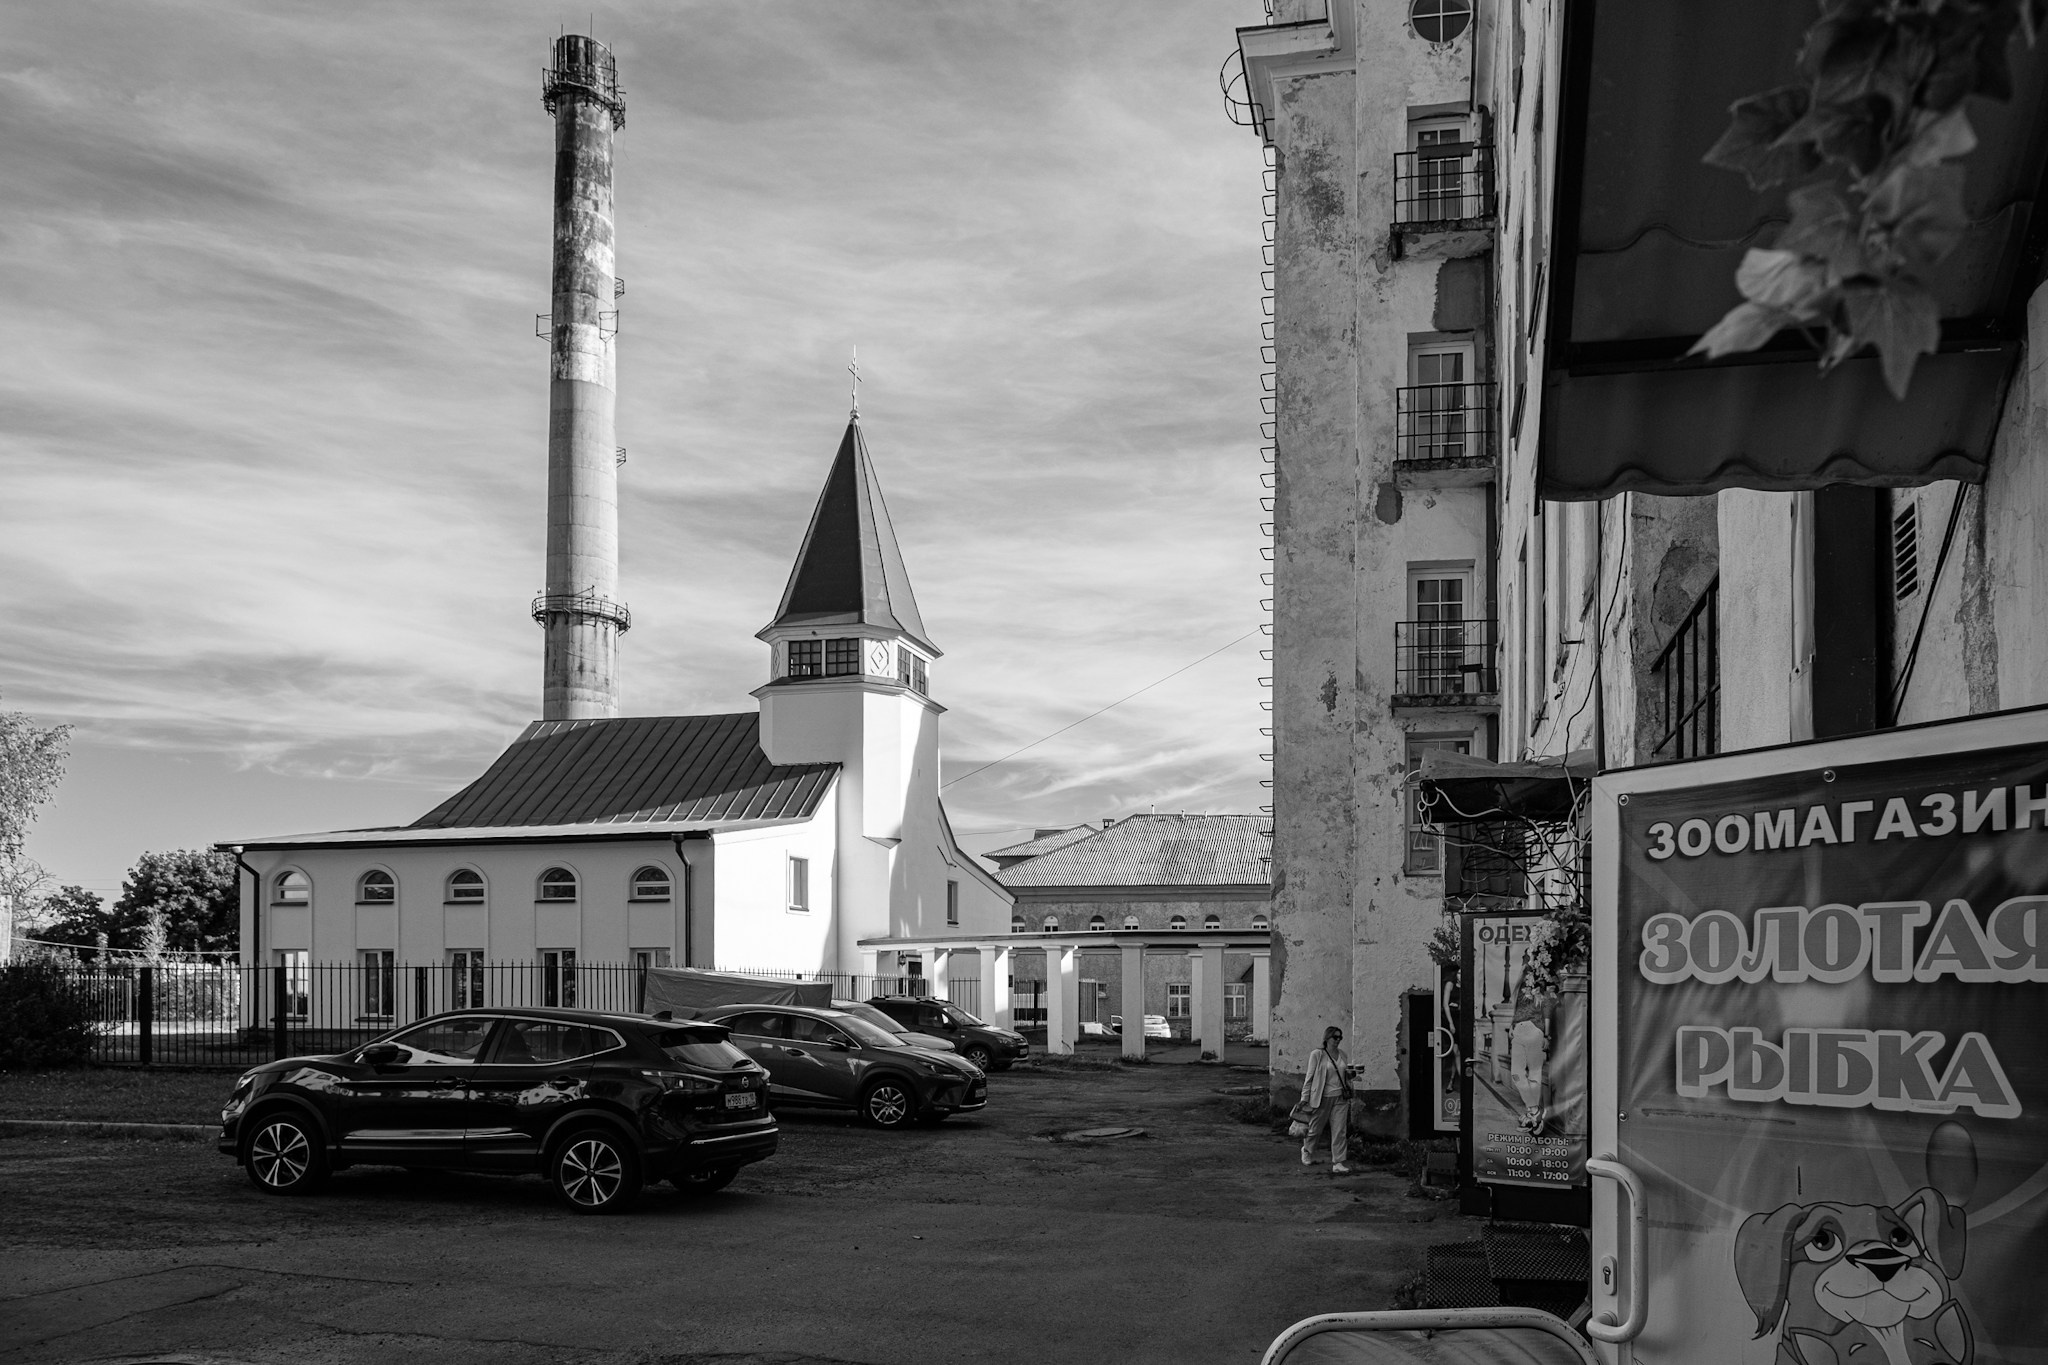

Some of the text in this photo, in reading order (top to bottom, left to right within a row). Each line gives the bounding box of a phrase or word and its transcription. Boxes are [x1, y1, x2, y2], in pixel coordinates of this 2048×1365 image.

[1647, 784, 2048, 860] ЗООМАГАЗИН
[1639, 896, 2048, 985] ЗОЛОТАЯ
[1676, 1025, 2023, 1119] РЫБКА
[1488, 1133, 1569, 1146] РЕЖИМ РАБОТЫ:
[1506, 1145, 1532, 1155] 10:00
[1541, 1147, 1568, 1157] 19:00
[1506, 1157, 1532, 1167] 10:00
[1541, 1159, 1569, 1169] 18:00
[1507, 1169, 1531, 1178] 11:00
[1542, 1171, 1569, 1181] 17:00
